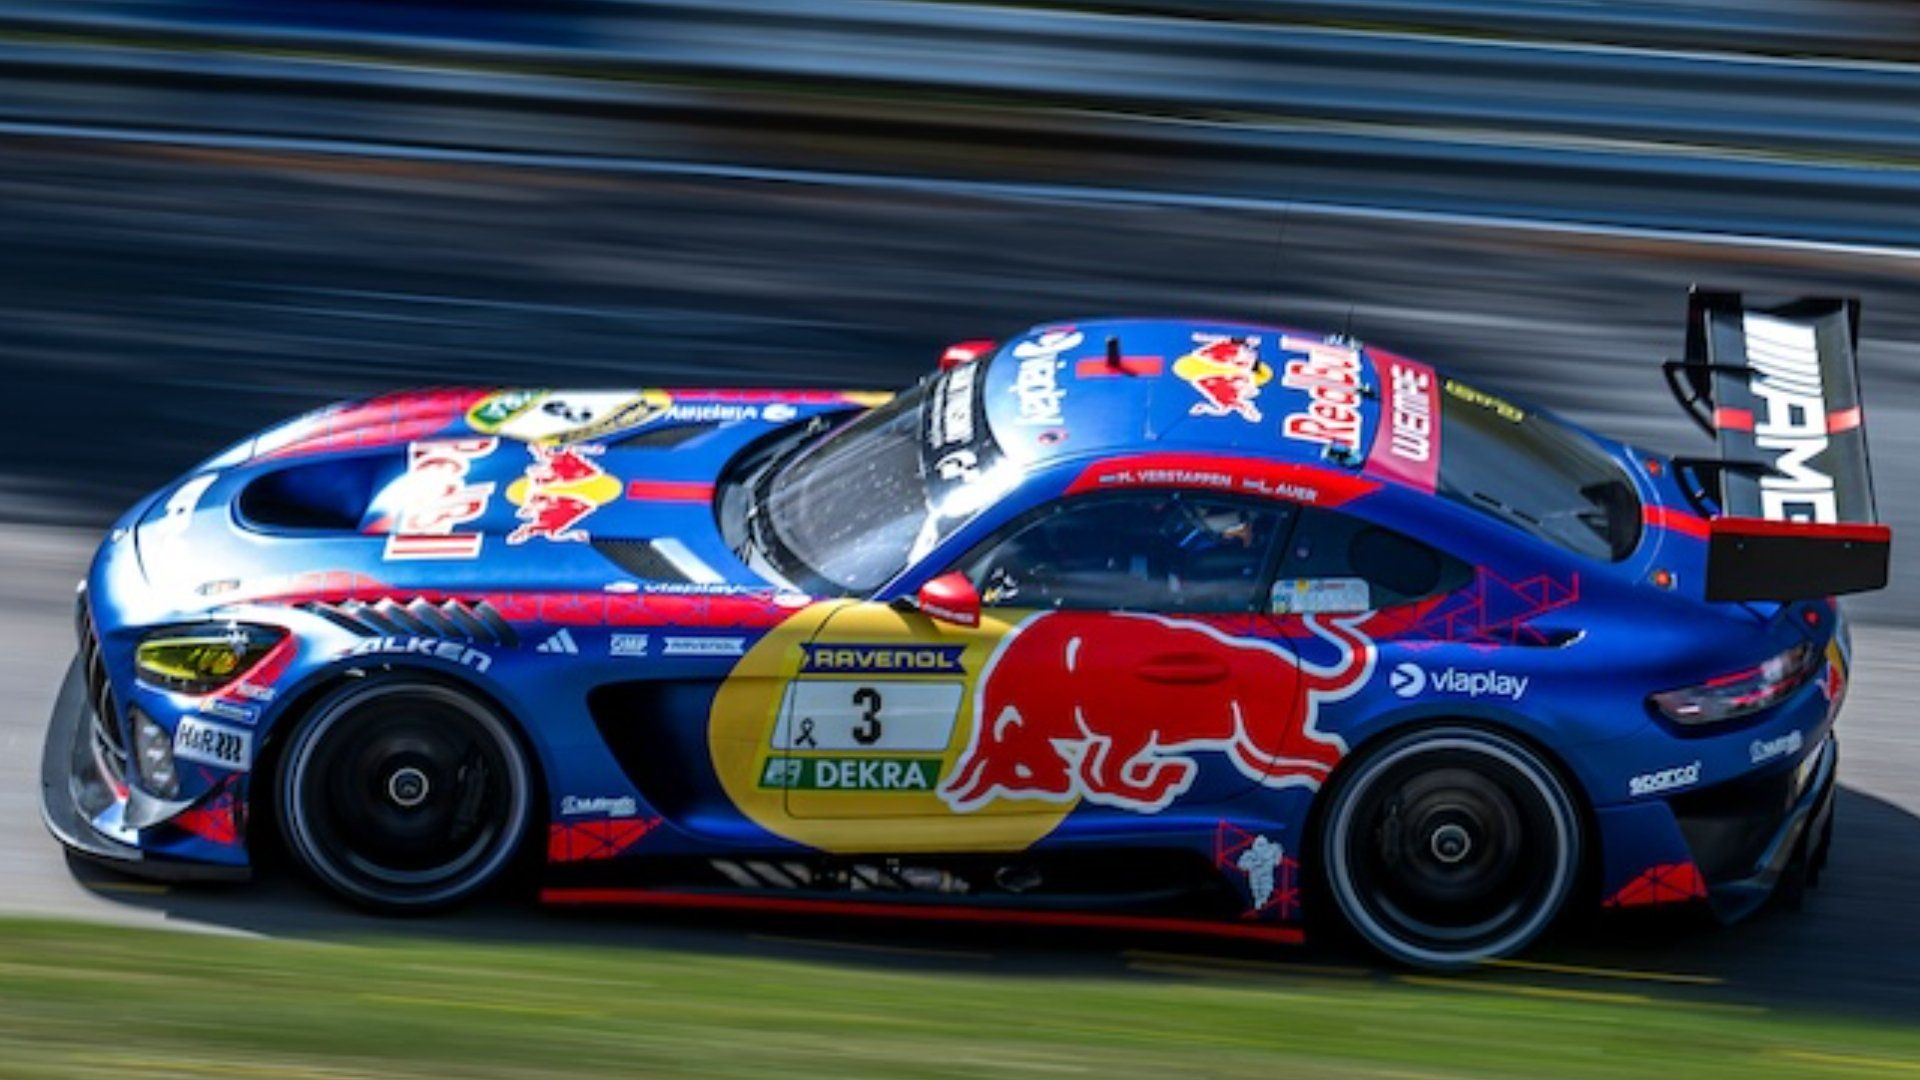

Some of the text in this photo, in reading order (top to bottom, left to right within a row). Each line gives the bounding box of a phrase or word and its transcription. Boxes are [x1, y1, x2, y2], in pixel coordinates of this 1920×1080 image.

[1391, 363, 1431, 462] WEMPE
[1138, 470, 1232, 487] VERSTAPPEN
[1276, 483, 1318, 502] AUER
[340, 636, 493, 674] ALKEN
[814, 651, 953, 669] RAVENOL
[1431, 667, 1529, 700] viaplay
[853, 686, 882, 746] 3
[815, 761, 927, 788] DEKRA
